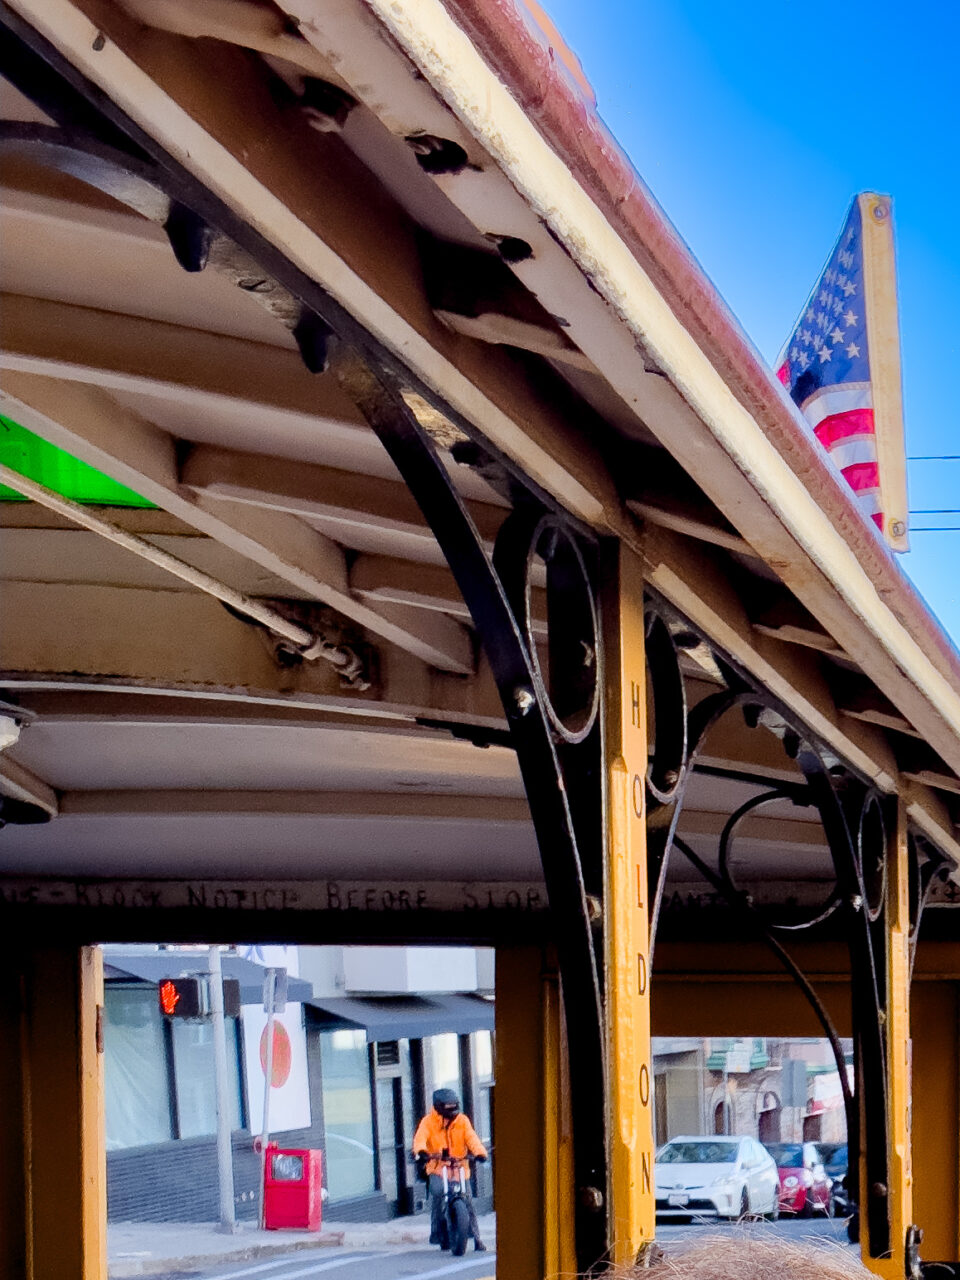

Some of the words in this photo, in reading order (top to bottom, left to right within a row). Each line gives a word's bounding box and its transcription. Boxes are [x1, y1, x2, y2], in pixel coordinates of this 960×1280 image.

[326, 880, 428, 912] BEFORE
[631, 680, 647, 996] HOLD
[638, 1063, 652, 1196] ON
